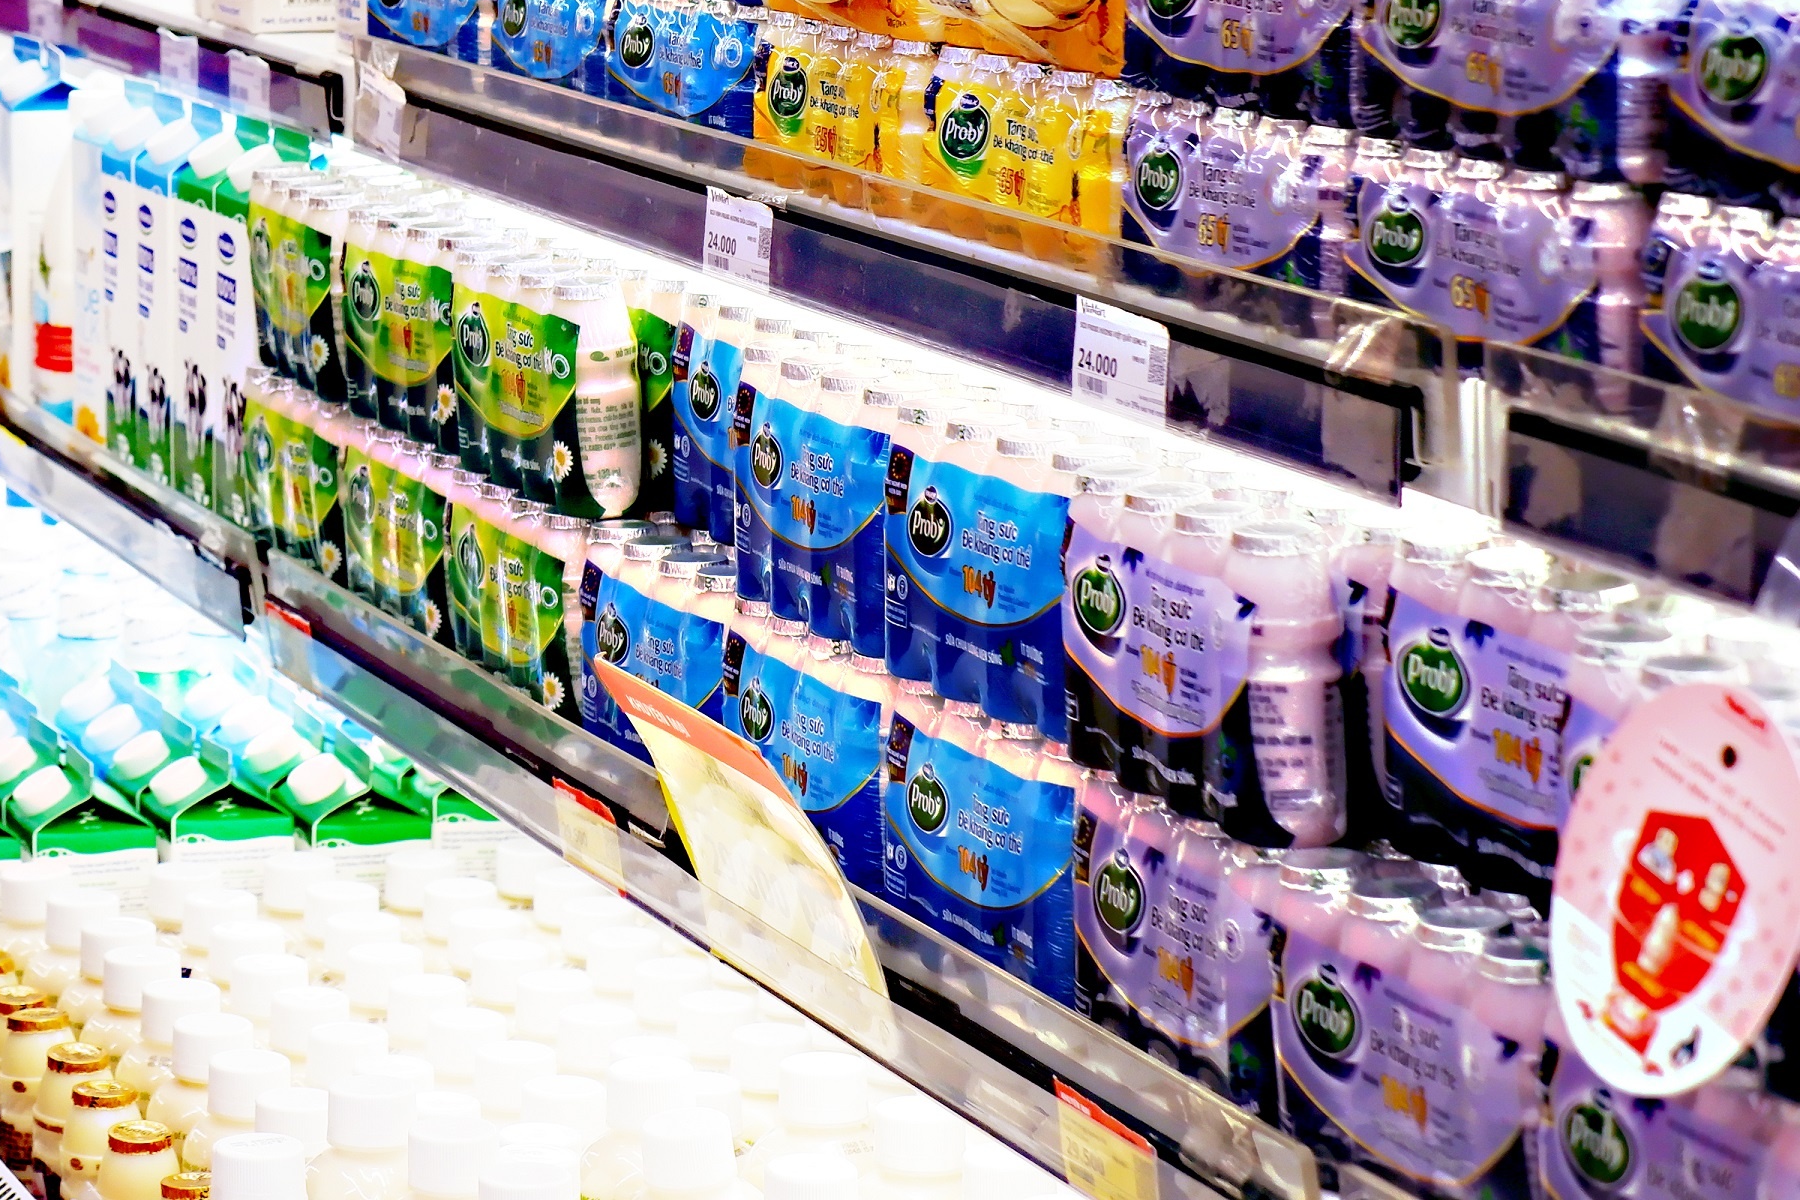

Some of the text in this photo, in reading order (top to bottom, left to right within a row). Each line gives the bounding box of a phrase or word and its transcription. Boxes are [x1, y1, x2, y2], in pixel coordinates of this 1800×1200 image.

[624, 34, 652, 57] Proby
[1221, 19, 1240, 49] 65
[772, 78, 804, 104] Proby
[819, 79, 837, 102] Tăng
[814, 125, 829, 153] 65
[945, 116, 985, 153] Proby
[1006, 119, 1027, 141] Tăng
[993, 134, 1003, 150] Đề
[1004, 136, 1027, 162] kháng
[999, 166, 1015, 194] 65
[1139, 162, 1176, 191] Proby
[1202, 160, 1228, 186] Tăng
[708, 231, 737, 256] 24.000
[1198, 213, 1216, 246] 65
[1372, 220, 1419, 250] Proby
[1451, 274, 1476, 309] 65
[1680, 290, 1737, 332] Proby
[518, 328, 534, 348] sức
[1077, 347, 1118, 378] 24.000
[691, 379, 716, 411] Proby
[754, 447, 777, 475] Proby
[817, 450, 834, 473] sức
[820, 474, 831, 493] cơ
[790, 494, 806, 523] 104
[911, 509, 946, 544] Proby
[999, 518, 1018, 542] sức
[962, 528, 974, 549] Đề
[1001, 544, 1013, 563] cơ
[1016, 544, 1032, 570] thể
[508, 560, 524, 578] sức
[962, 564, 997, 609] 104 tỷ
[1080, 577, 1116, 617] Proby
[1169, 597, 1193, 620] sức
[598, 620, 625, 650] Proby
[662, 636, 675, 656] sức
[664, 658, 673, 674] cơ
[1407, 652, 1459, 699] Proby
[743, 702, 769, 731] Proby
[808, 713, 825, 737] sức
[812, 737, 822, 755] cơ
[782, 752, 798, 782] 104
[911, 783, 942, 820] Proby
[991, 801, 1011, 827] sức
[995, 830, 1006, 850] cơ
[1007, 830, 1024, 857] thể
[957, 845, 977, 879] 104
[1100, 873, 1137, 913] Proby
[1300, 987, 1351, 1040] Proby
